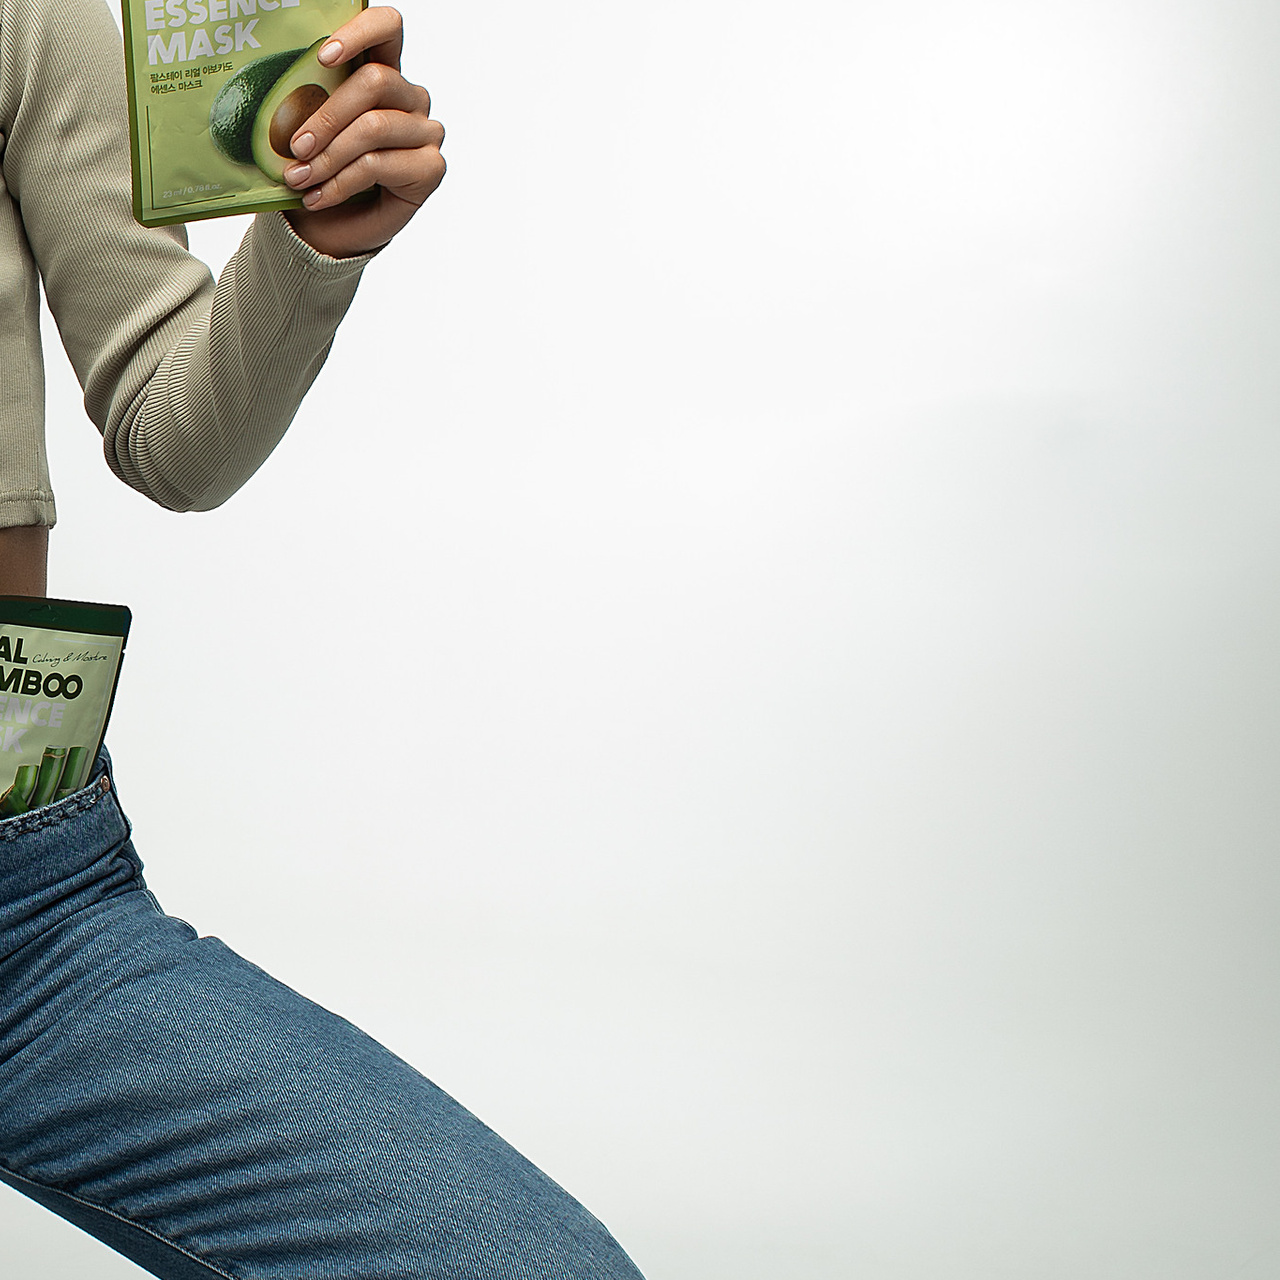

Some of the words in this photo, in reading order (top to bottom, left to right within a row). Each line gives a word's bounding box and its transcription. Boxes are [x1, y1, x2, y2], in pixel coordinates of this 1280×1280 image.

[147, 20, 262, 66] MASK
[150, 70, 183, 83] 팜스테이
[185, 67, 201, 78] 리얼
[202, 61, 234, 75] 아보카도
[150, 83, 177, 95] 에센스
[178, 79, 203, 91] 마스크
[163, 189, 173, 199] 23
[63, 652, 74, 662] &
